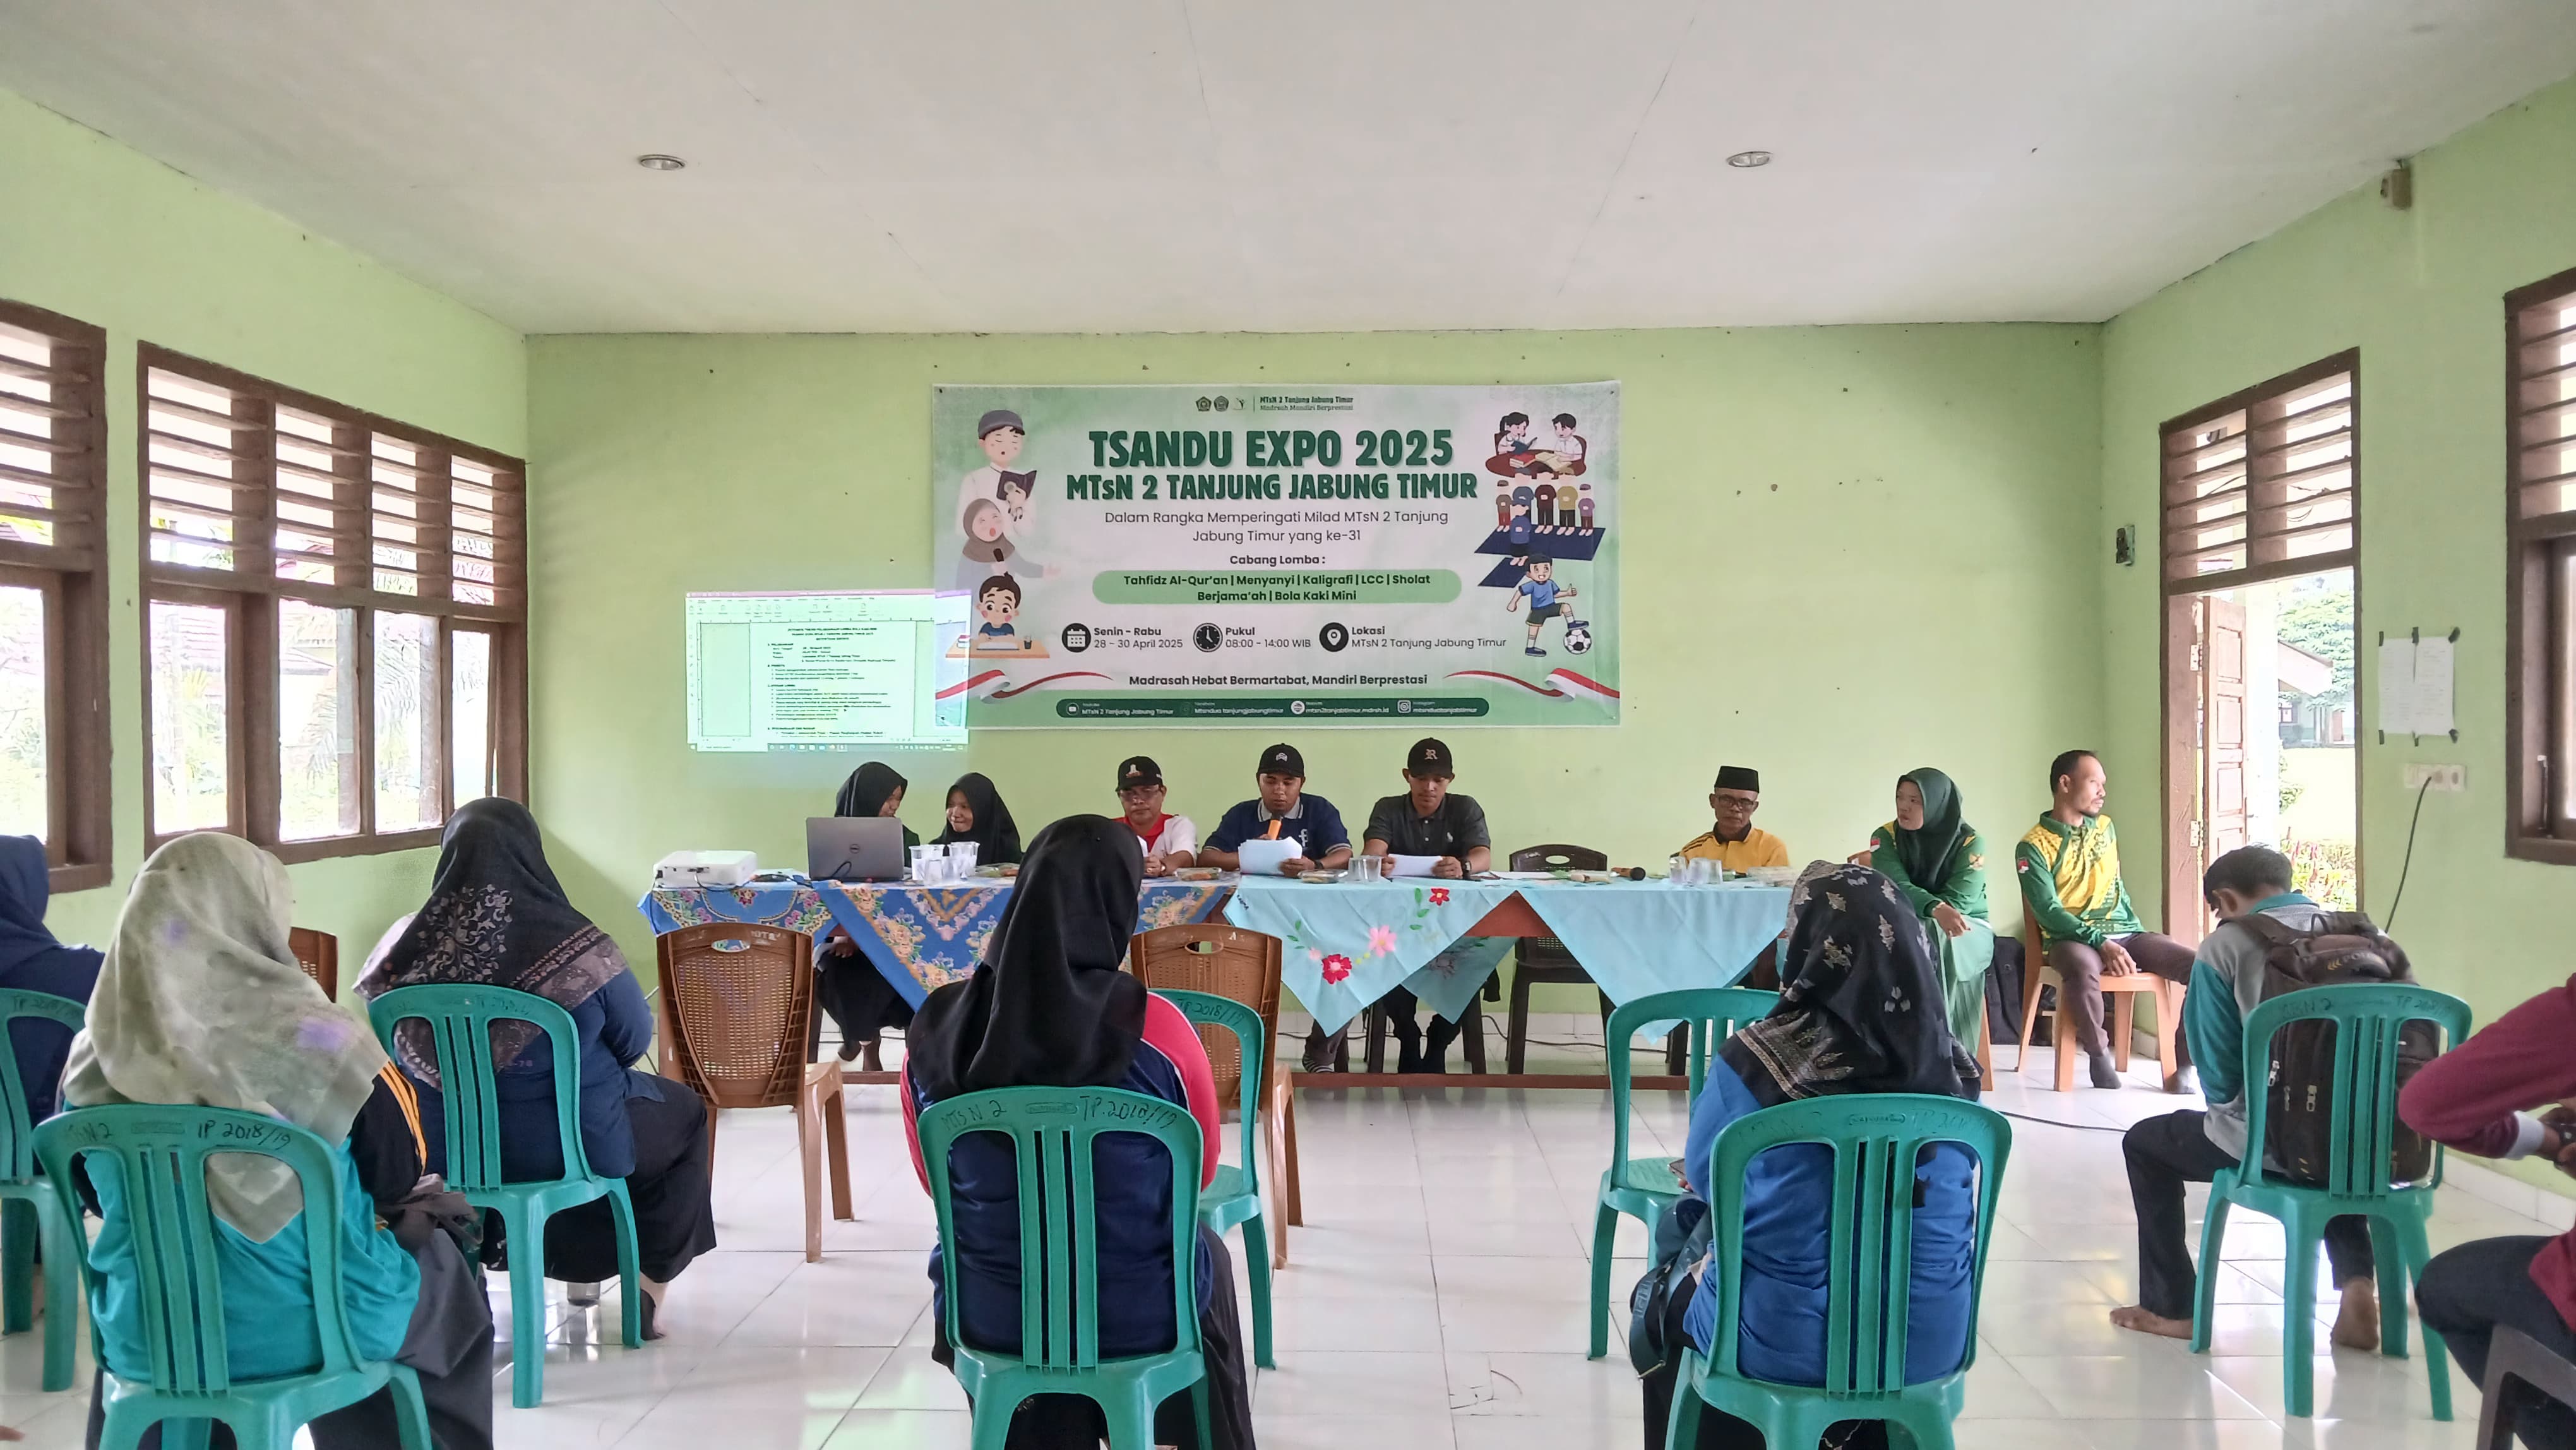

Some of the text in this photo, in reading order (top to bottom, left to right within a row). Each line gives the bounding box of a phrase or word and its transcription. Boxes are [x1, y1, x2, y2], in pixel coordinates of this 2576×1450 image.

[1088, 429, 1453, 468] TSANDU EXPO 2025
[1067, 472, 1477, 500] MTsN 2 TANJUNG JABUNG TIMUR
[1106, 511, 1448, 526] Dalam Rangka Memperingati Milad MTsN 2 Tanjung
[1193, 530, 1361, 544] Jabung Timur yang ke-31
[1230, 555, 1276, 567] Cabang
[1280, 554, 1319, 565] Lomba
[1124, 575, 1167, 585] Tahfidz
[1170, 575, 1227, 586] Al-Qur'an
[1237, 575, 1294, 587] Menyanyi
[1303, 575, 1352, 587] Kaligrafi
[1362, 575, 1384, 584] LCC
[1393, 574, 1431, 584] Sholat
[1198, 591, 1267, 603] Berjama'ah
[1275, 591, 1301, 601] Bola
[1304, 590, 1329, 601] Kaki
[1332, 590, 1356, 601] Mini
[1094, 626, 1123, 635] Senin
[1134, 626, 1161, 635] Rabu
[1226, 626, 1255, 635] Pukul
[1352, 626, 1385, 635] Lokasi
[1094, 639, 1106, 648] 28
[1118, 639, 1130, 648] 30
[1133, 639, 1155, 650] April
[1159, 639, 1183, 648] 2025
[1225, 639, 1254, 648] 08:00
[1265, 639, 1289, 648] 14:00
[1292, 639, 1311, 648] WIB
[1352, 638, 1507, 650] MTsN 2 Tanjung Jabung Timur
[1130, 674, 1428, 687] Madrasah Hebat Bermartabat, Mandiri Berprestasi
[989, 1099, 1007, 1117] 2
[222, 1122, 291, 1151] 2018/19
